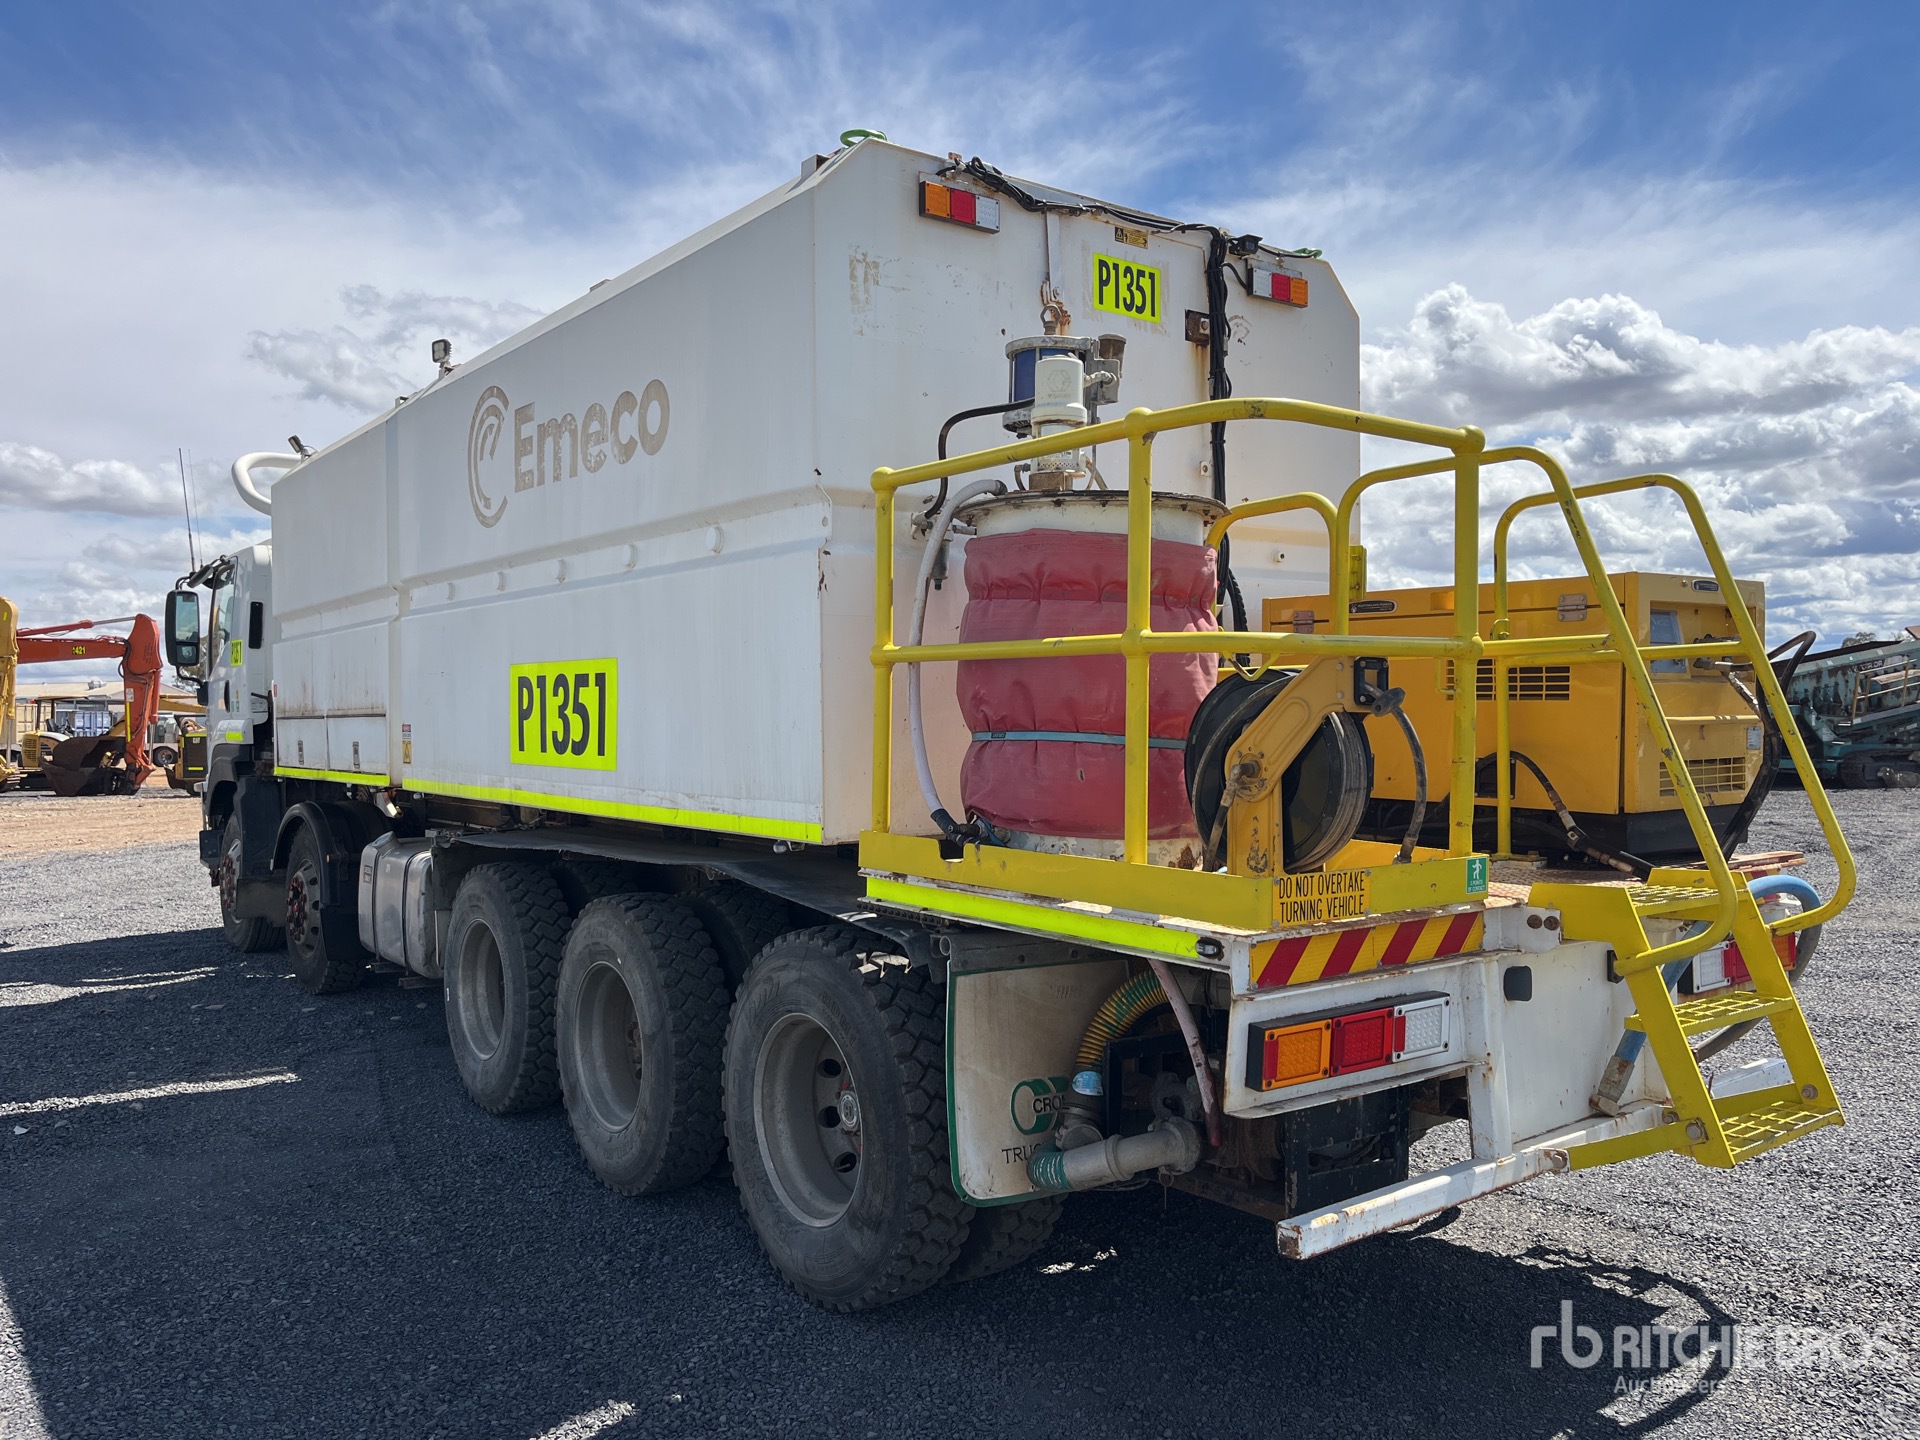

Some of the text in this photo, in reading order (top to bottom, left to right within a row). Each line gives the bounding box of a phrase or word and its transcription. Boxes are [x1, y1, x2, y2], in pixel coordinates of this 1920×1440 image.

[1098, 258, 1156, 318] P1351
[514, 379, 668, 494] Emeco
[517, 672, 607, 757] P1351
[1279, 870, 1365, 899] DO NOT OVERTAKE
[1280, 894, 1365, 923] TURNING VEHICLE
